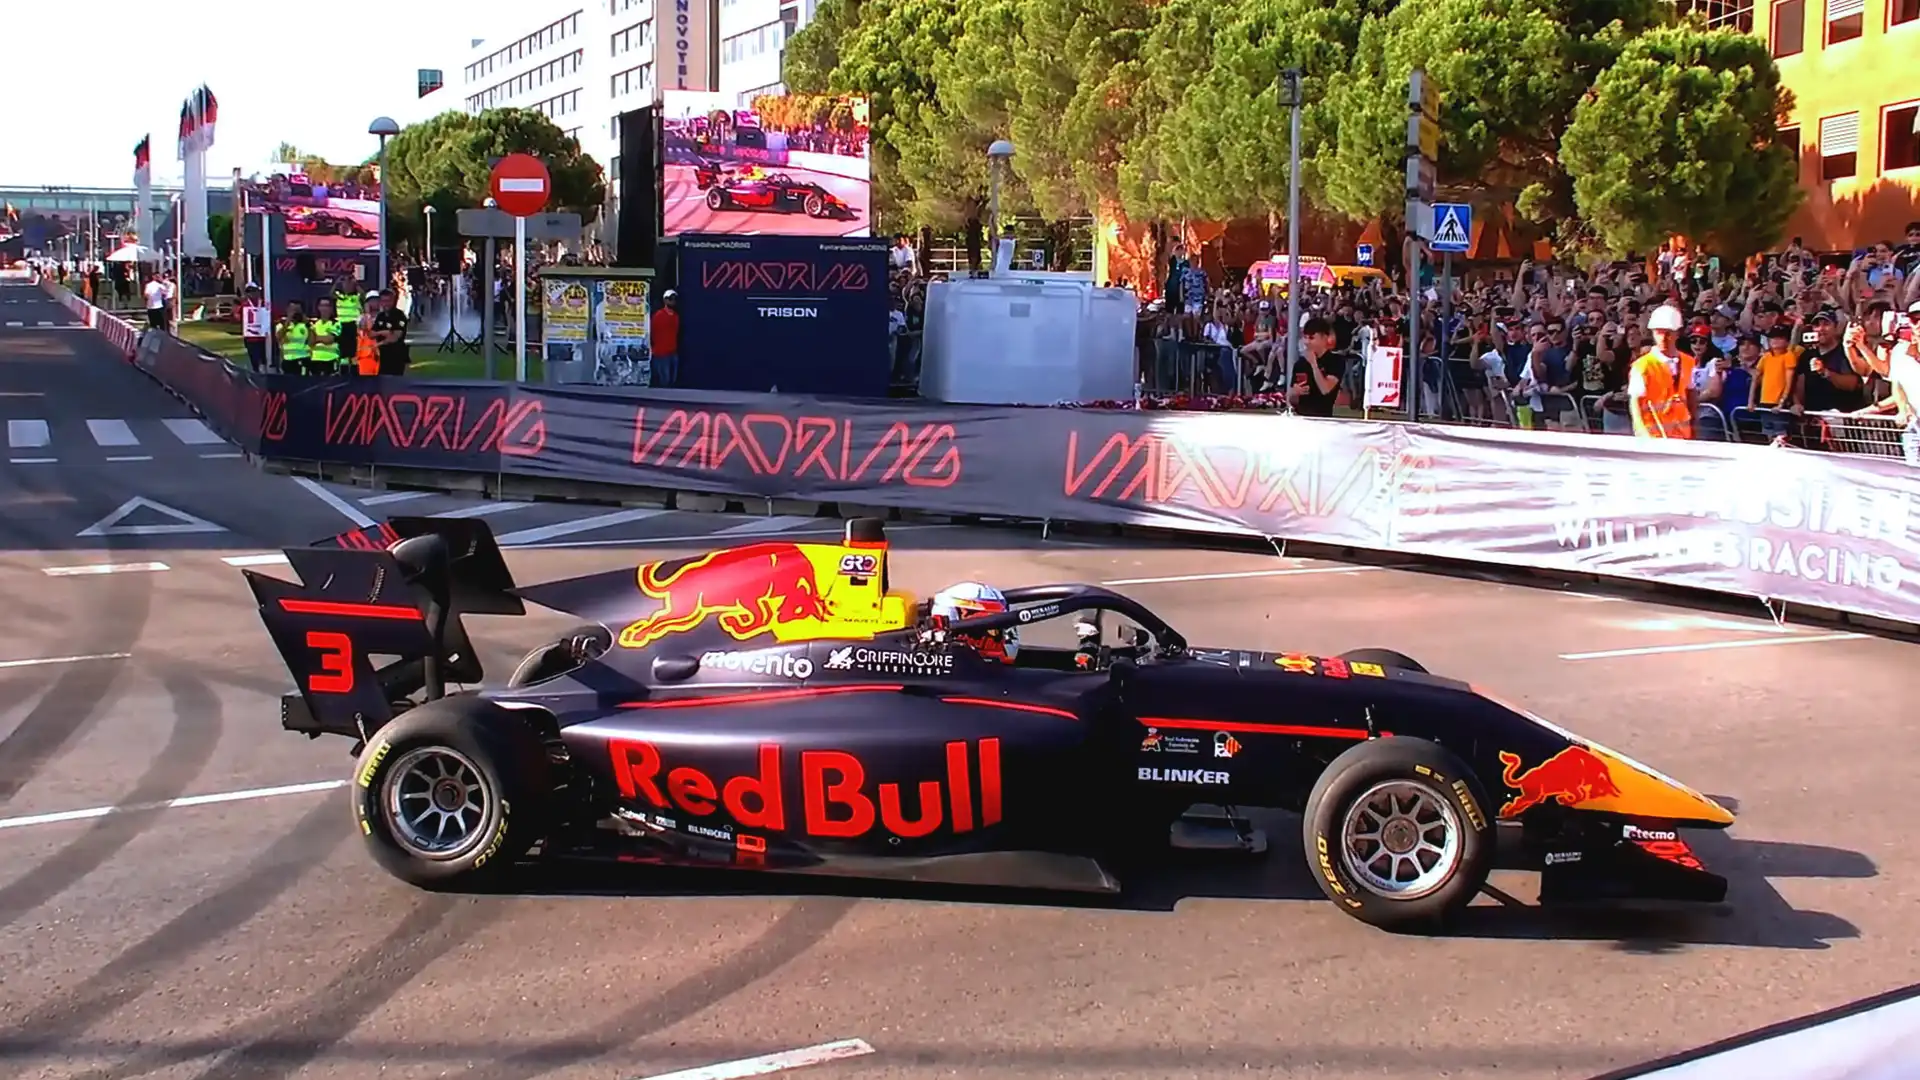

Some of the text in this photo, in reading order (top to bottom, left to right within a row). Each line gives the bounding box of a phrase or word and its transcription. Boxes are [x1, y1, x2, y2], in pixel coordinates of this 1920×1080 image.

[676, 0, 688, 90] NOVOTEL
[703, 261, 868, 290] MADRING
[757, 307, 818, 318] TRISON
[324, 393, 546, 455] MADRING
[632, 406, 961, 487] MADRING
[1750, 538, 1901, 592] RACING
[305, 632, 354, 693] 3
[700, 651, 814, 679] movento
[856, 648, 953, 667] GRIFFINCORE
[608, 737, 1001, 838] Red Bull
[1138, 767, 1230, 784] BLINKER
[1315, 835, 1347, 896] ZERO
